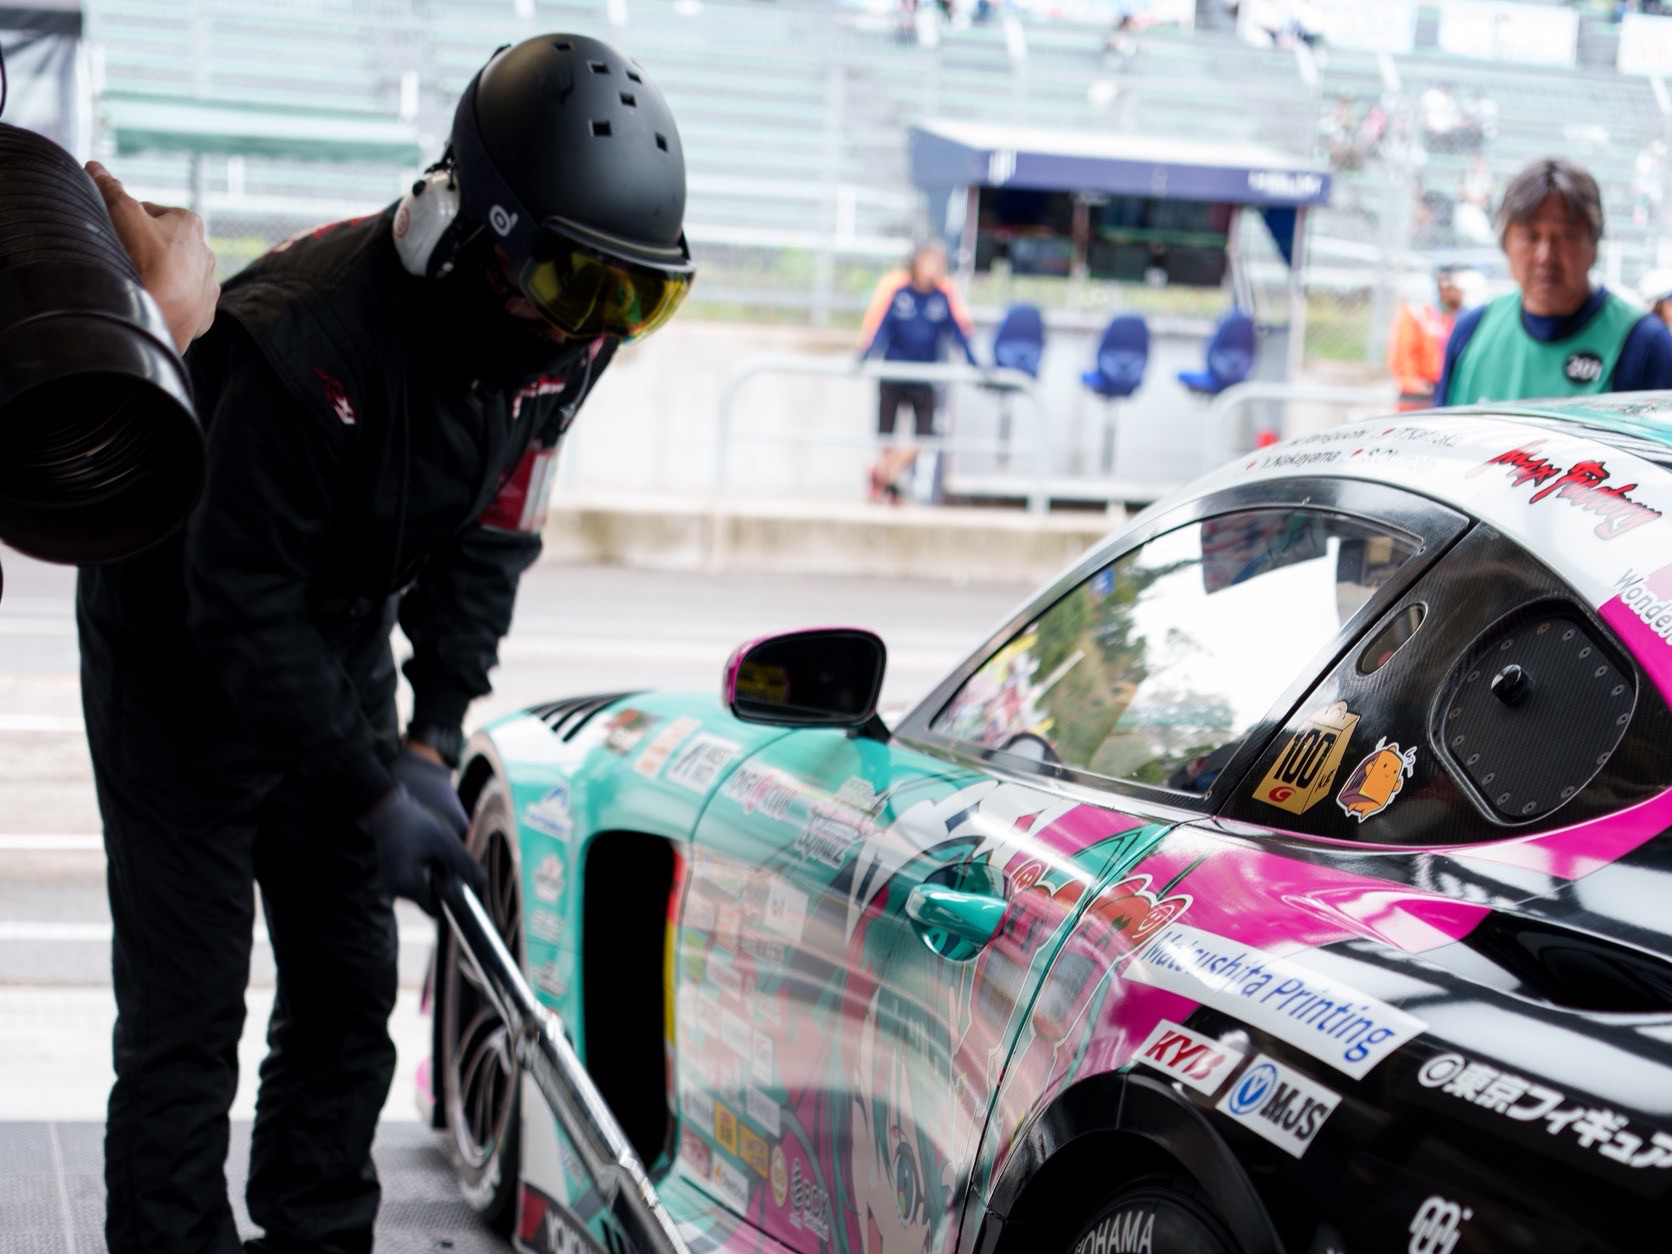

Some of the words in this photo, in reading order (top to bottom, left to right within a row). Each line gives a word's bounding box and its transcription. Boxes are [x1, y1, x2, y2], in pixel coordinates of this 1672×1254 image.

[1273, 728, 1337, 790] 100
[1141, 931, 1273, 997] Matsushita
[1260, 977, 1396, 1063] Printing
[1144, 1029, 1226, 1081] KYB
[1259, 1081, 1330, 1142] MJS
[1442, 1060, 1672, 1169] 東京フィギュア
